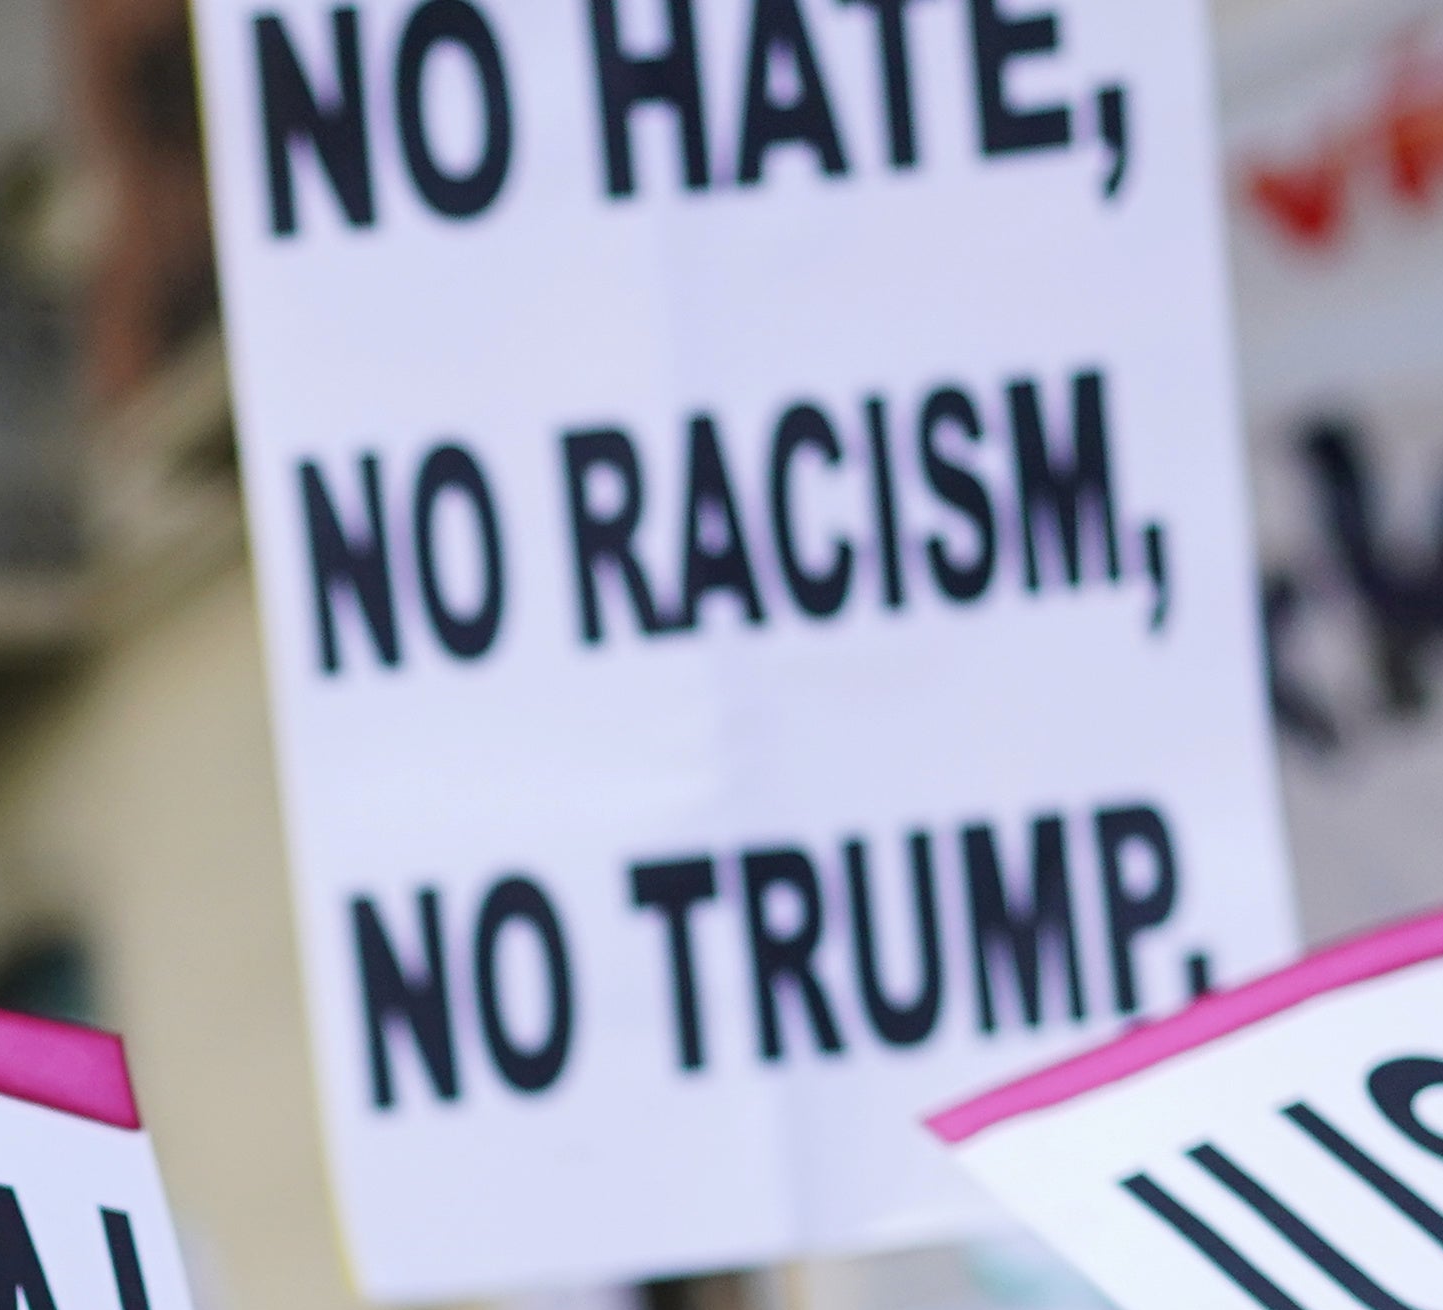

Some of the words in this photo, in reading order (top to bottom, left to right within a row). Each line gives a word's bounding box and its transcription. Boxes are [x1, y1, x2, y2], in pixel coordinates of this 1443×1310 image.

[248, 0, 517, 238] NO
[584, 0, 1130, 208] HATE,
[297, 440, 507, 678] NO
[559, 364, 1173, 638] RACISM,
[348, 872, 577, 1113] NO
